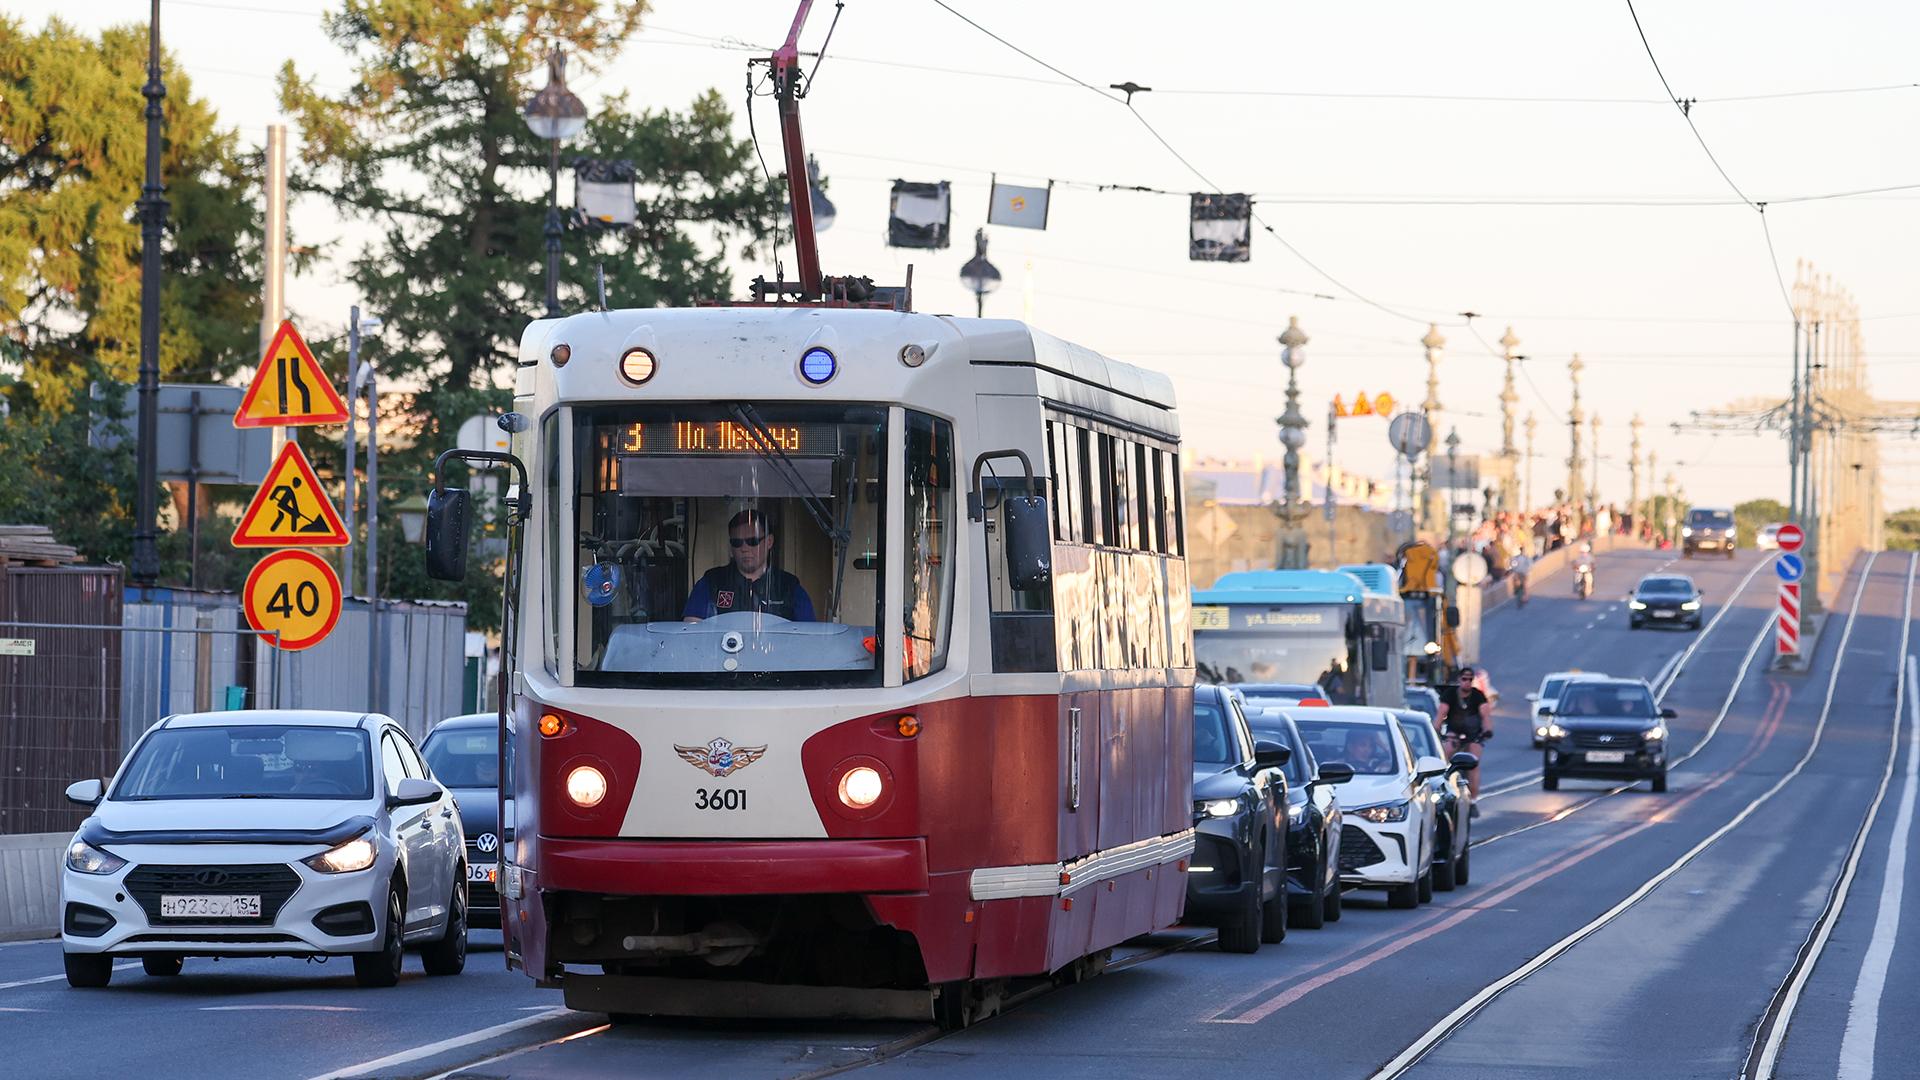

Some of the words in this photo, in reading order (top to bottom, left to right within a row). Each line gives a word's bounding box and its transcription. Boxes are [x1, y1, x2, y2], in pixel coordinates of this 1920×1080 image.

[624, 422, 642, 451] 3
[266, 580, 320, 619] 40
[1200, 611, 1219, 625] 76
[694, 788, 747, 811] 3601
[233, 898, 258, 910] 154
